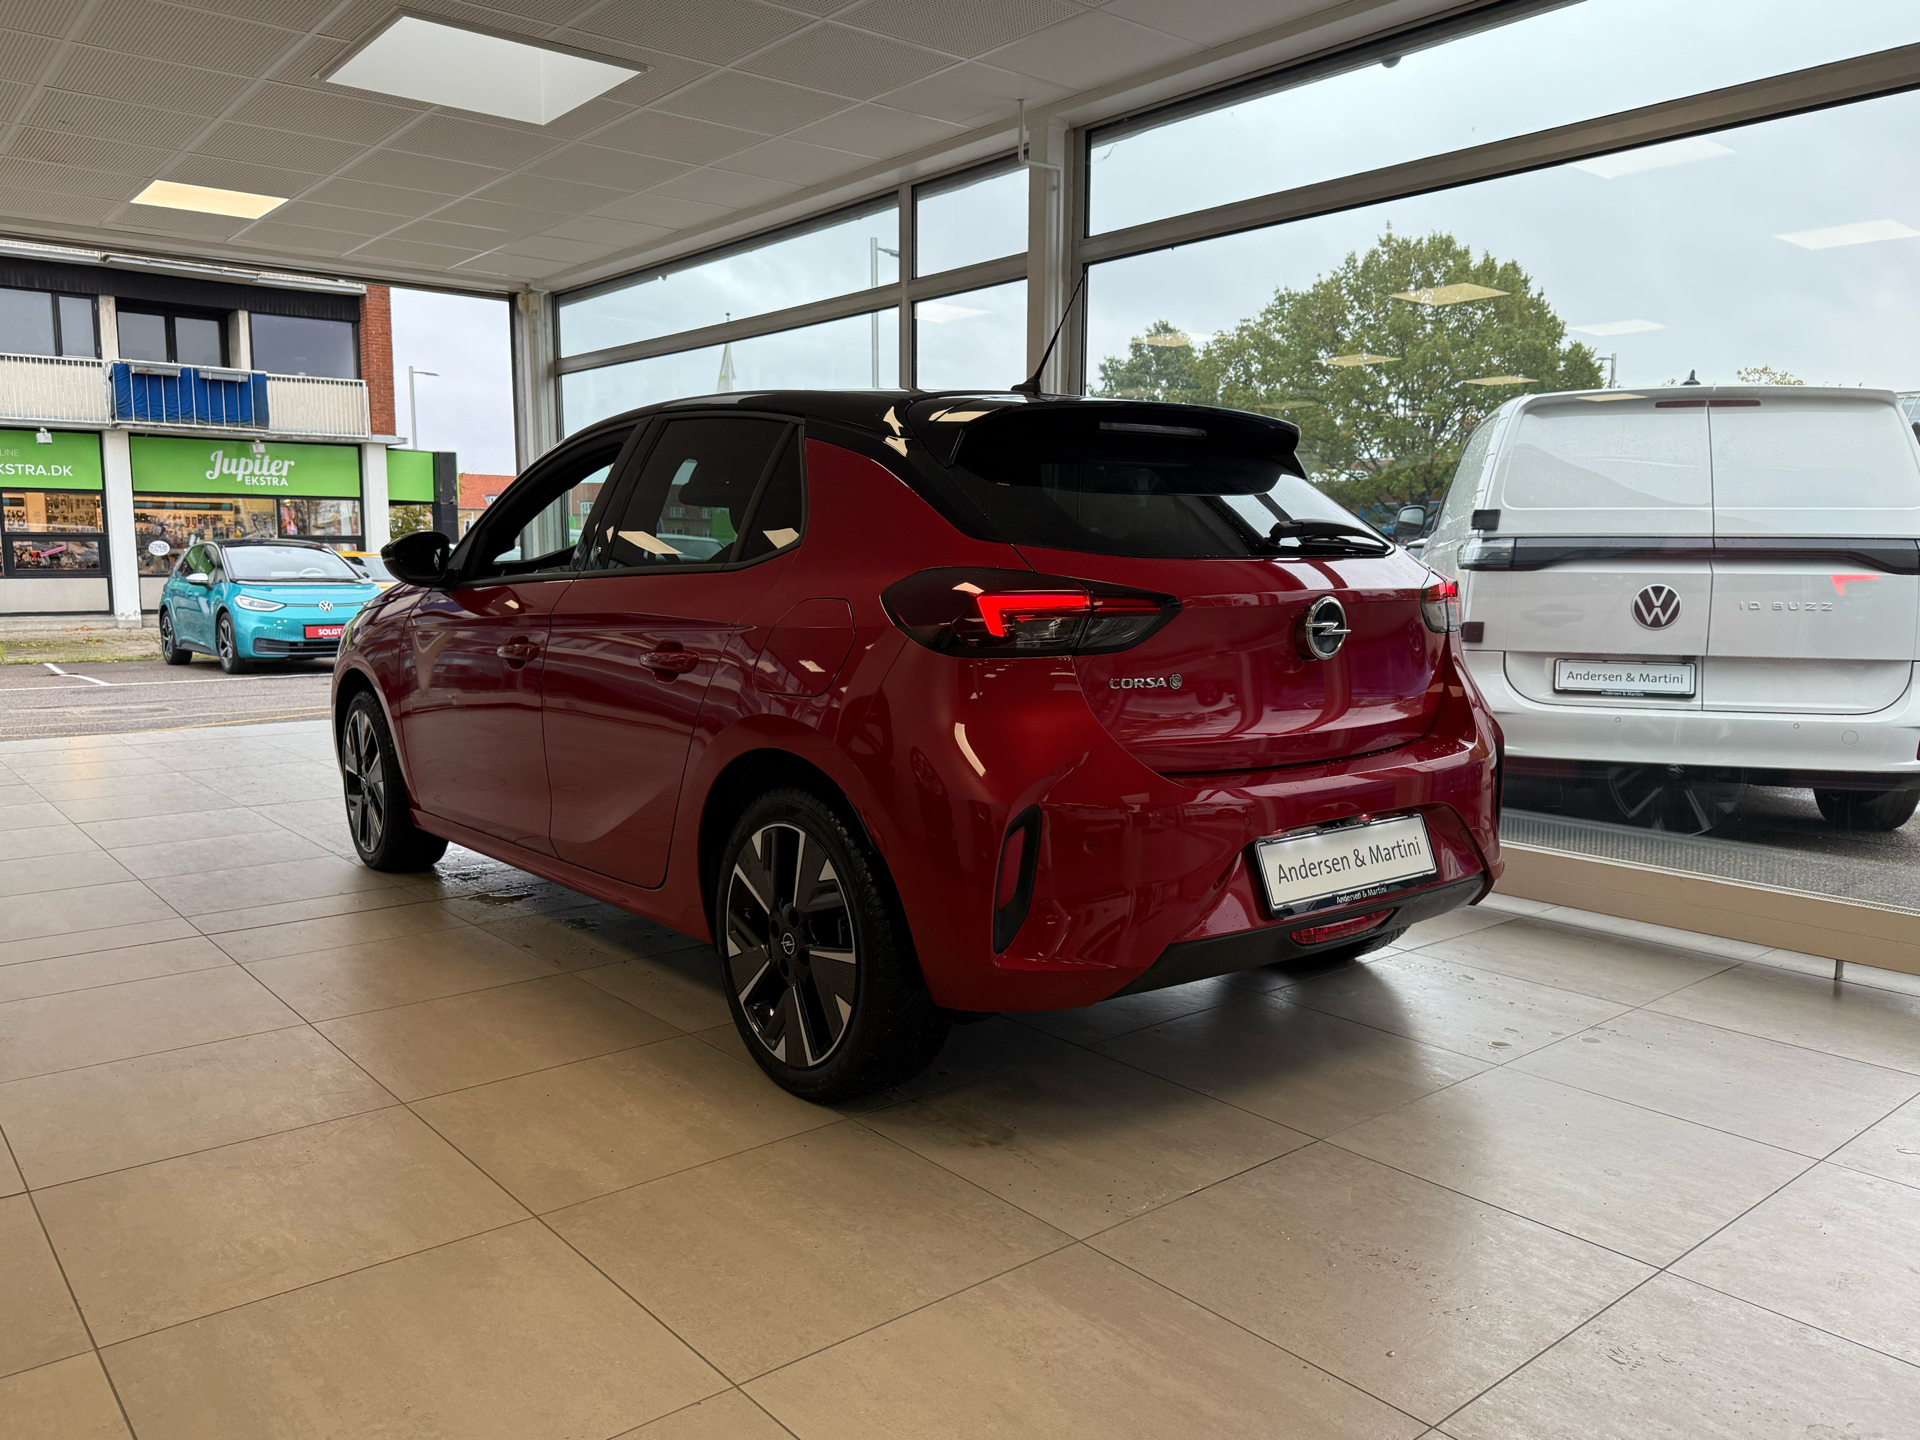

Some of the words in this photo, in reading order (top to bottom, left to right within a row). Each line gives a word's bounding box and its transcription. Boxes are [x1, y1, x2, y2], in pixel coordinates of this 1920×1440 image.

[205, 450, 295, 482] Jupiter
[245, 476, 289, 487] EKSTRA
[1772, 601, 1834, 612] BUZZ
[317, 628, 342, 636] SOLGT
[1109, 677, 1168, 689] CORSA
[1566, 670, 1623, 683] Andersen
[1625, 672, 1636, 683] &
[1638, 673, 1684, 684] Martini
[1278, 854, 1351, 885] Andersen
[1353, 848, 1367, 868] &
[1368, 836, 1422, 865] Martini
[1336, 891, 1361, 903] Andersen
[1367, 885, 1388, 897] Martini
